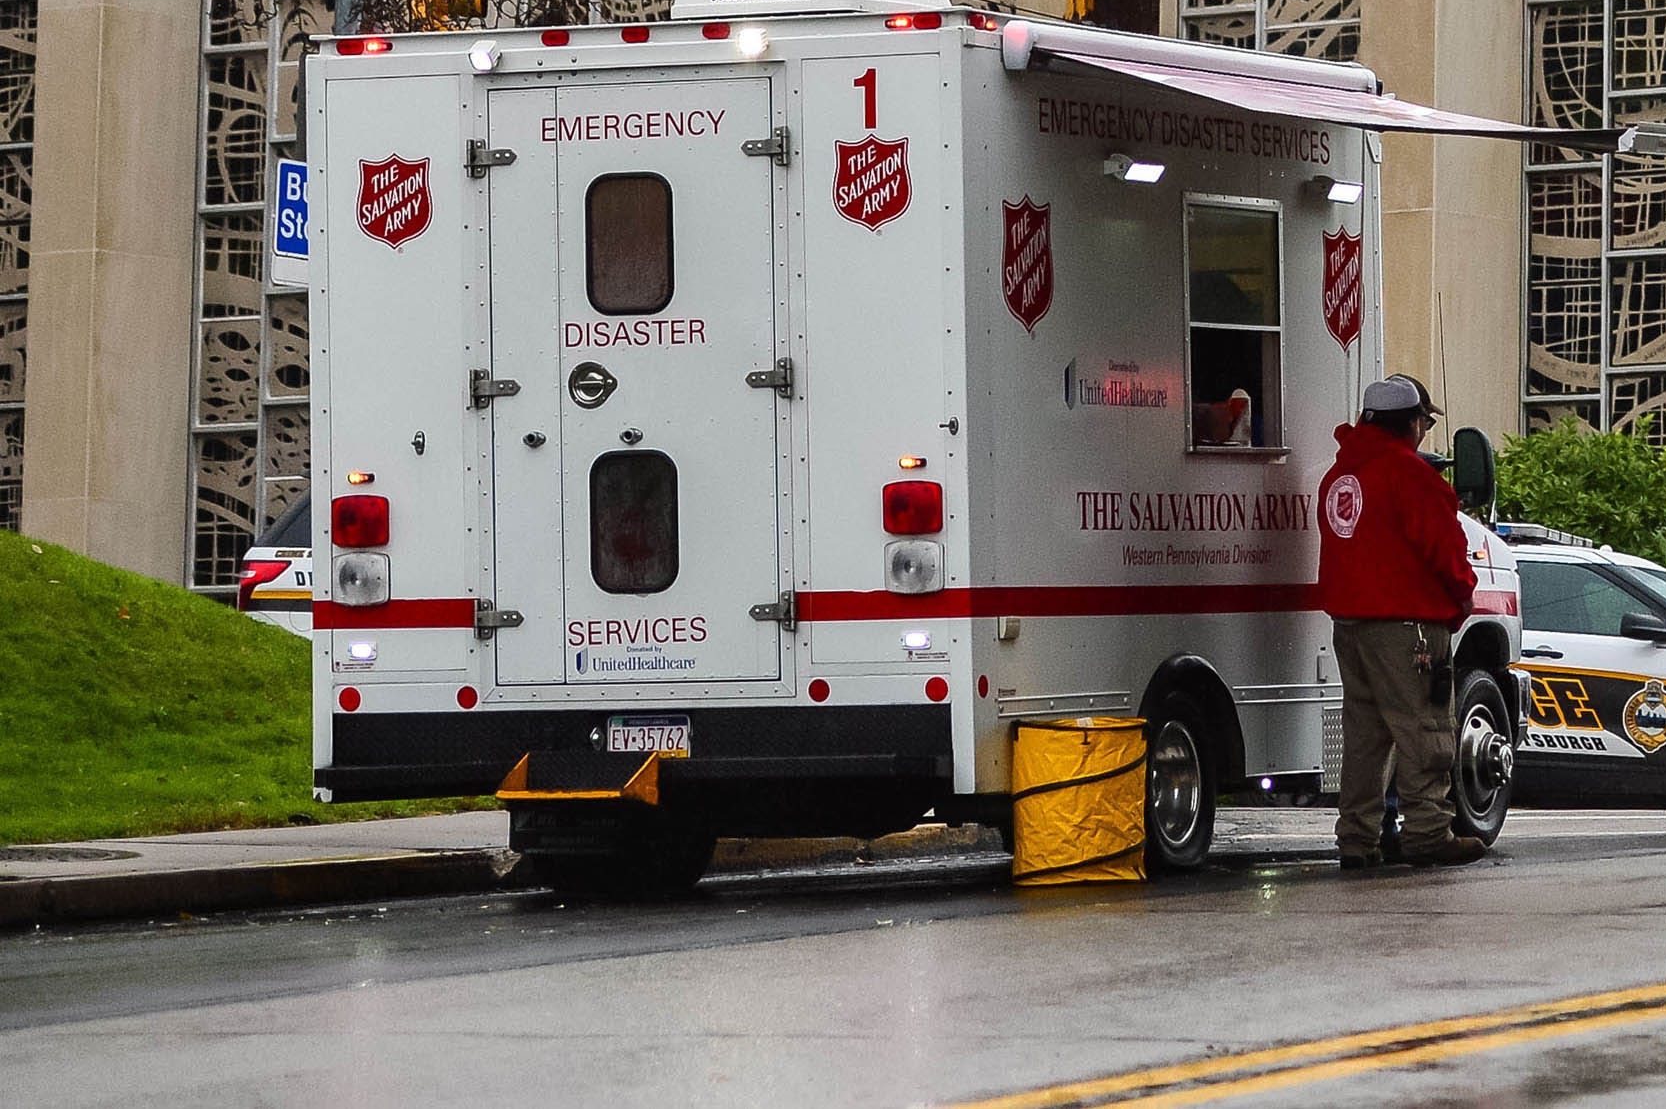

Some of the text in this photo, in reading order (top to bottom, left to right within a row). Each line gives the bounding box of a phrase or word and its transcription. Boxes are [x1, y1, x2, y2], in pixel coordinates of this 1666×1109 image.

[853, 68, 877, 130] 1
[540, 109, 726, 142] EMERGENCY
[1038, 98, 1331, 166] EMERGENCY DISASTER SERVICES
[371, 164, 400, 194] THE
[838, 148, 903, 208] SALVATION
[848, 145, 877, 175] THE
[362, 167, 424, 226] SALVATION
[383, 193, 422, 237] ARMY
[861, 175, 901, 220] ARMY
[1011, 210, 1031, 251] THE
[1005, 216, 1048, 296] SALVATION
[1329, 240, 1346, 278] THE
[1021, 255, 1047, 314] ARMY
[1338, 280, 1359, 335] ARMY
[564, 319, 706, 348] DISASTER
[1079, 378, 1168, 408] UnitedHealthcare
[1077, 491, 1124, 532] THE
[1129, 491, 1248, 532] SALVATION
[1251, 493, 1313, 532] ARMY
[1122, 544, 1272, 568] Western Pennsylvania Division
[567, 616, 708, 647] SERVICES
[592, 657, 696, 672] UnitedHealthcare
[1524, 733, 1608, 752] TSBURGH
